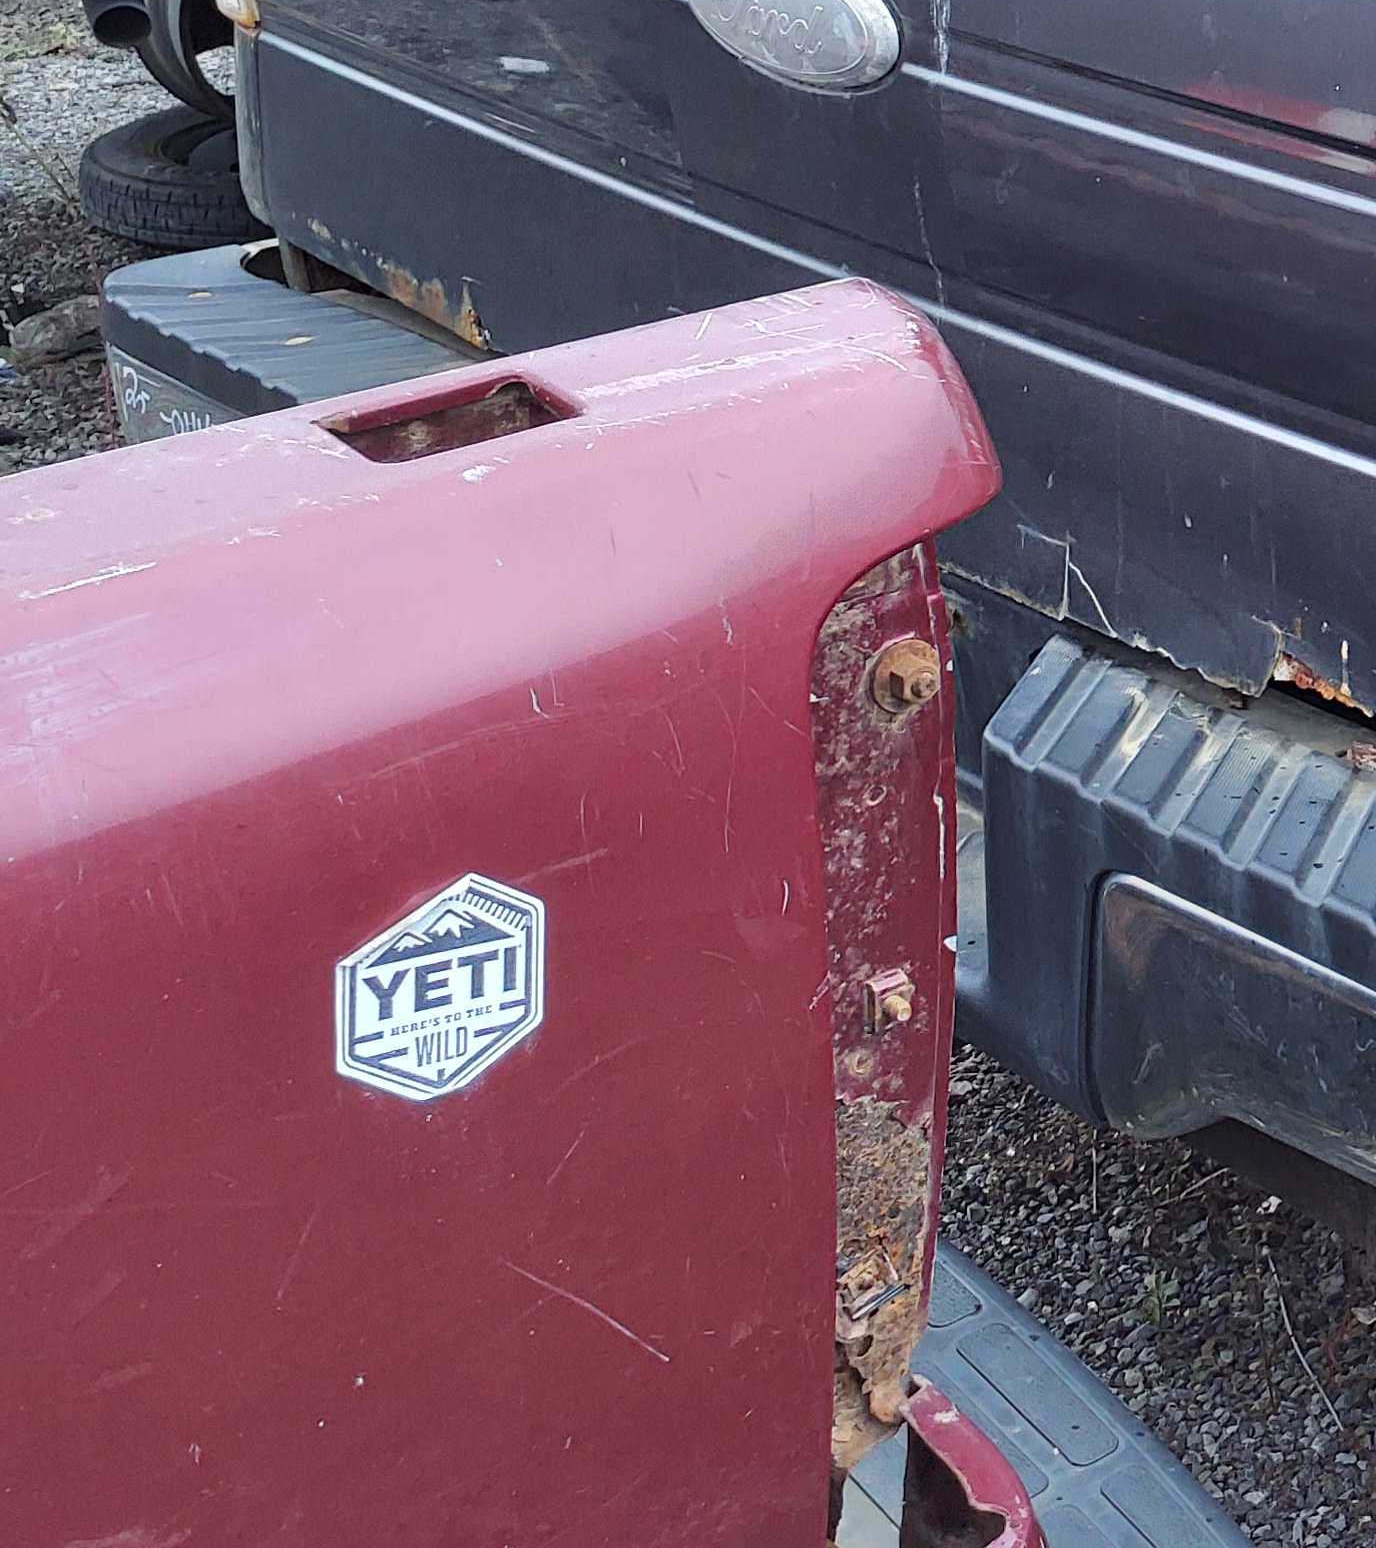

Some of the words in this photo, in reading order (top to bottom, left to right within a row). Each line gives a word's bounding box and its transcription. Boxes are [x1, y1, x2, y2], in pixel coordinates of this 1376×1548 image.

[361, 946, 518, 1022] YETI
[391, 1017, 440, 1037] HERE'S
[444, 1012, 462, 1024] TO
[466, 1005, 493, 1019] THE
[415, 1026, 467, 1068] WILD
